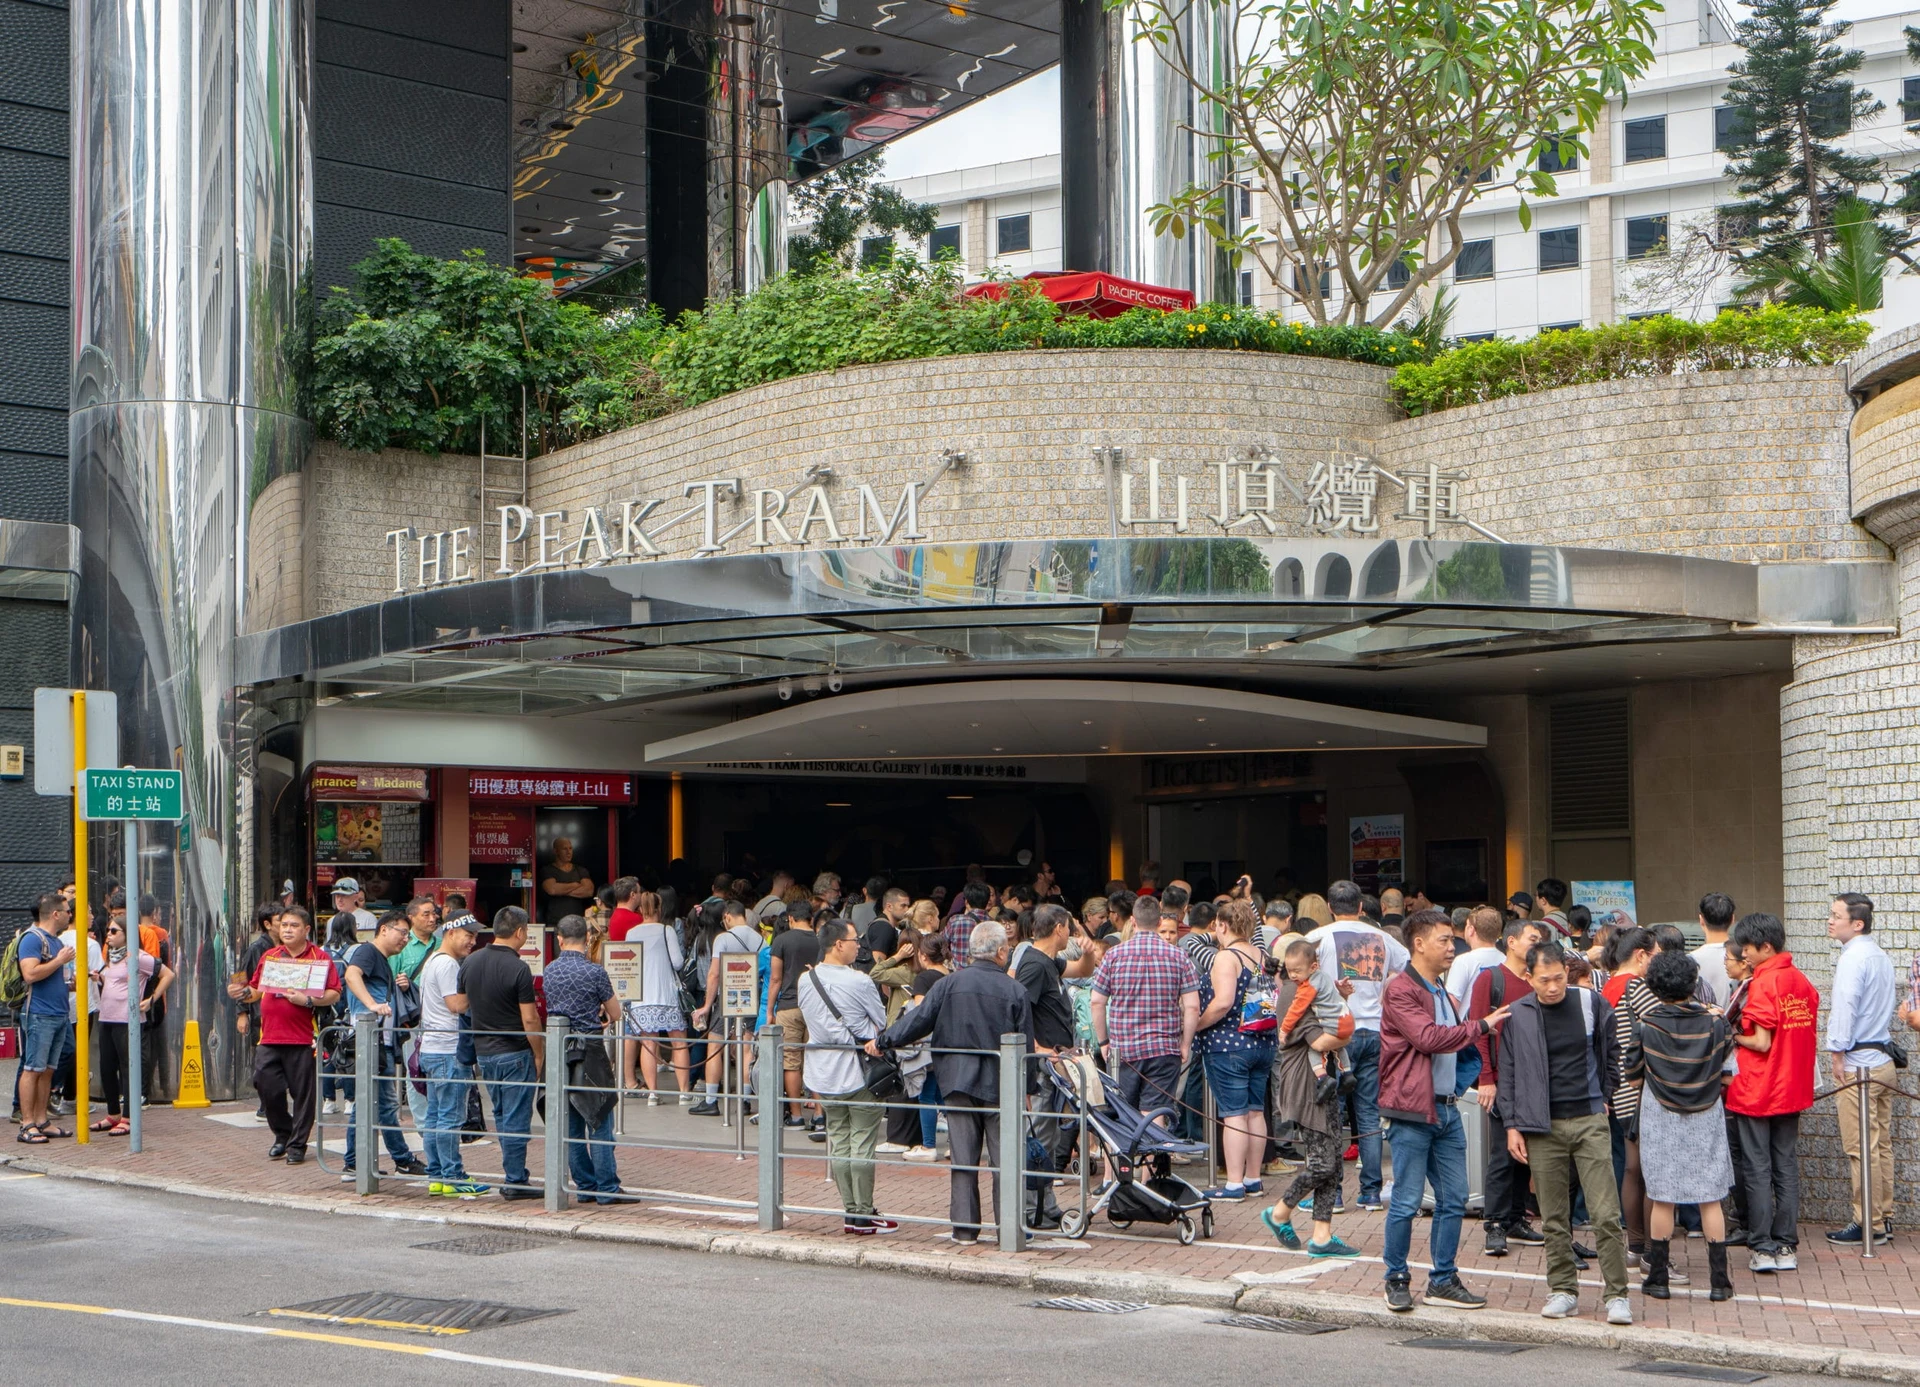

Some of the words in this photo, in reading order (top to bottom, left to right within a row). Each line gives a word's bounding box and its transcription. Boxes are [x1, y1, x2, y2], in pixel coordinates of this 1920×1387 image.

[1108, 284, 1145, 302] PACIFIC
[1146, 293, 1183, 310] COFFEE
[1119, 456, 1470, 536] 山頂纜車
[386, 526, 475, 594] THE
[495, 500, 665, 575] PEAK
[683, 477, 928, 553] TRAM
[803, 759, 873, 773] HISTORICAL
[873, 760, 922, 775] GALLERY
[91, 775, 123, 789] TAXI
[127, 776, 175, 790] STAND
[373, 776, 424, 789] Madame
[107, 795, 162, 812] 的士站
[475, 832, 510, 845] 售票處
[470, 847, 487, 856] KET
[487, 847, 525, 856] COUNTER
[1576, 889, 1596, 897] GREAT
[1597, 889, 1612, 897] PEAK
[1596, 895, 1629, 907] OFFERS
